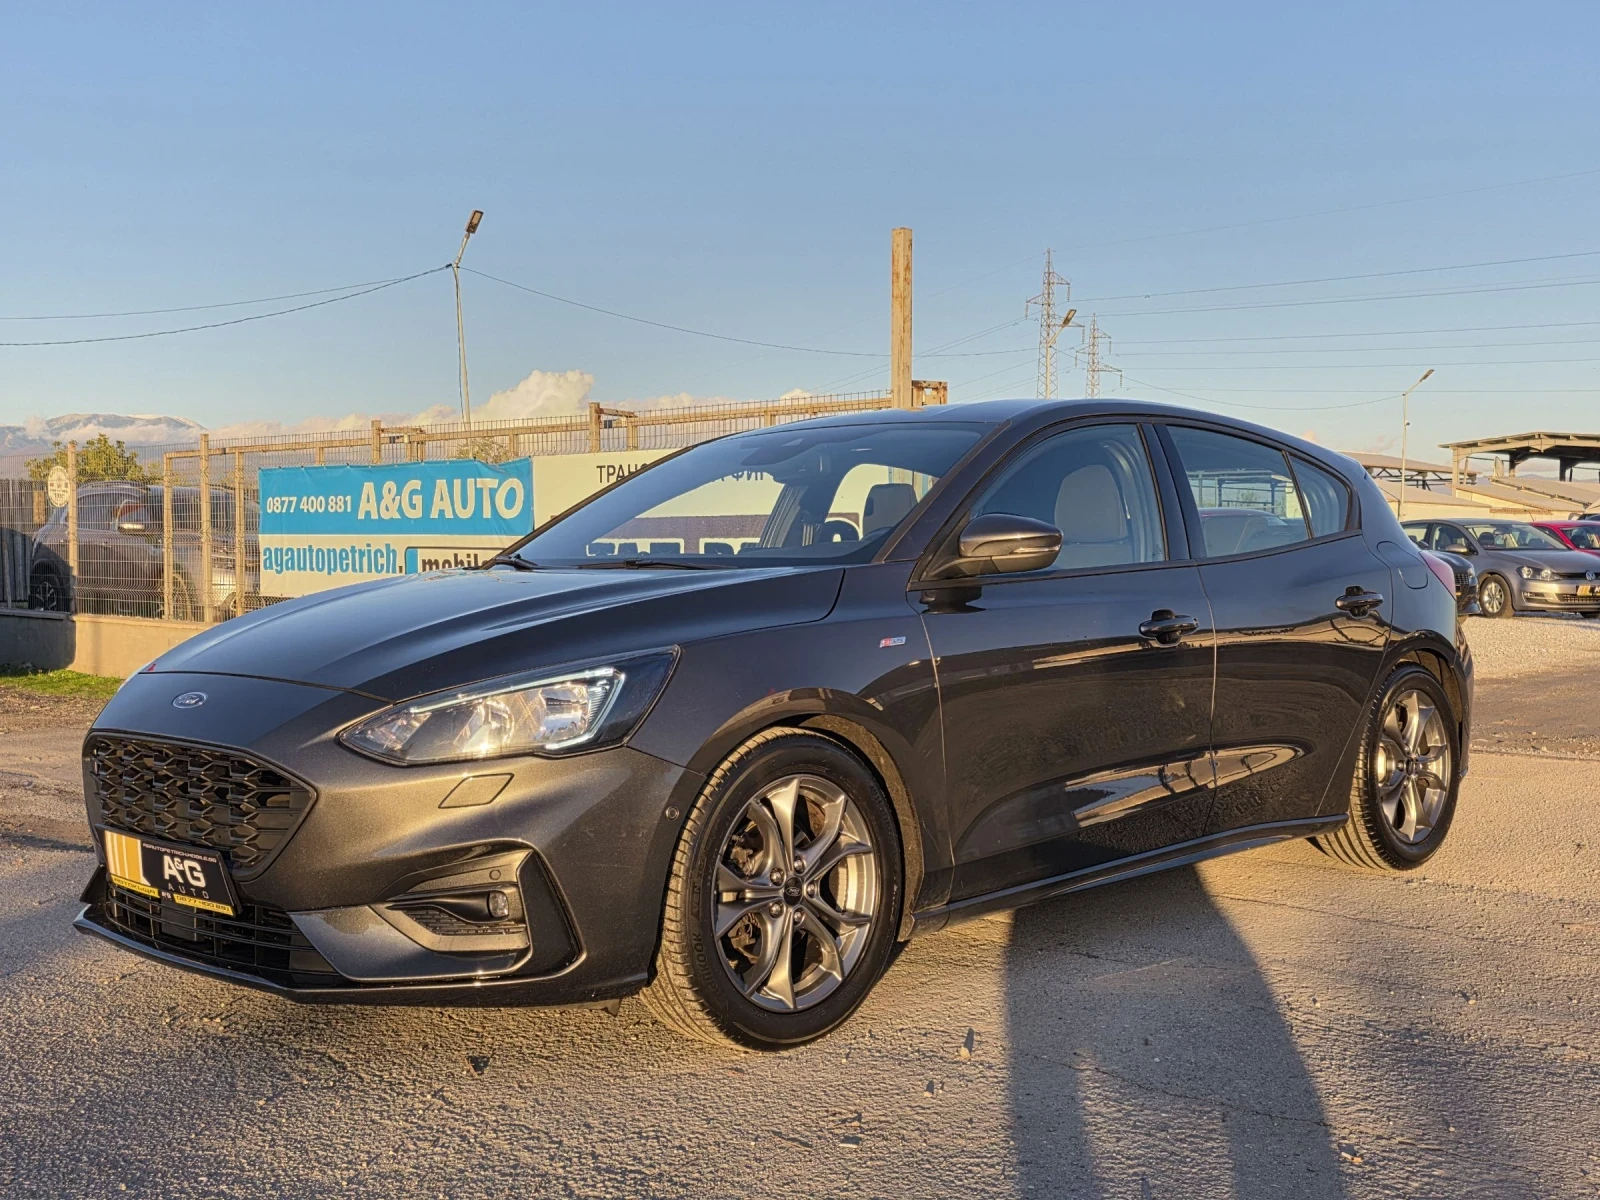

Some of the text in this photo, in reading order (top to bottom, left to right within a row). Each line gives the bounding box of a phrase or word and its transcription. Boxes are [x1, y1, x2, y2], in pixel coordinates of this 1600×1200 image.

[596, 463, 648, 483] ТРАН
[266, 495, 352, 513] 0877 400 881
[358, 478, 524, 520] A&G AUTO
[163, 855, 206, 888] A&G
[168, 882, 210, 900] AUTO
[176, 895, 197, 904] 0877
